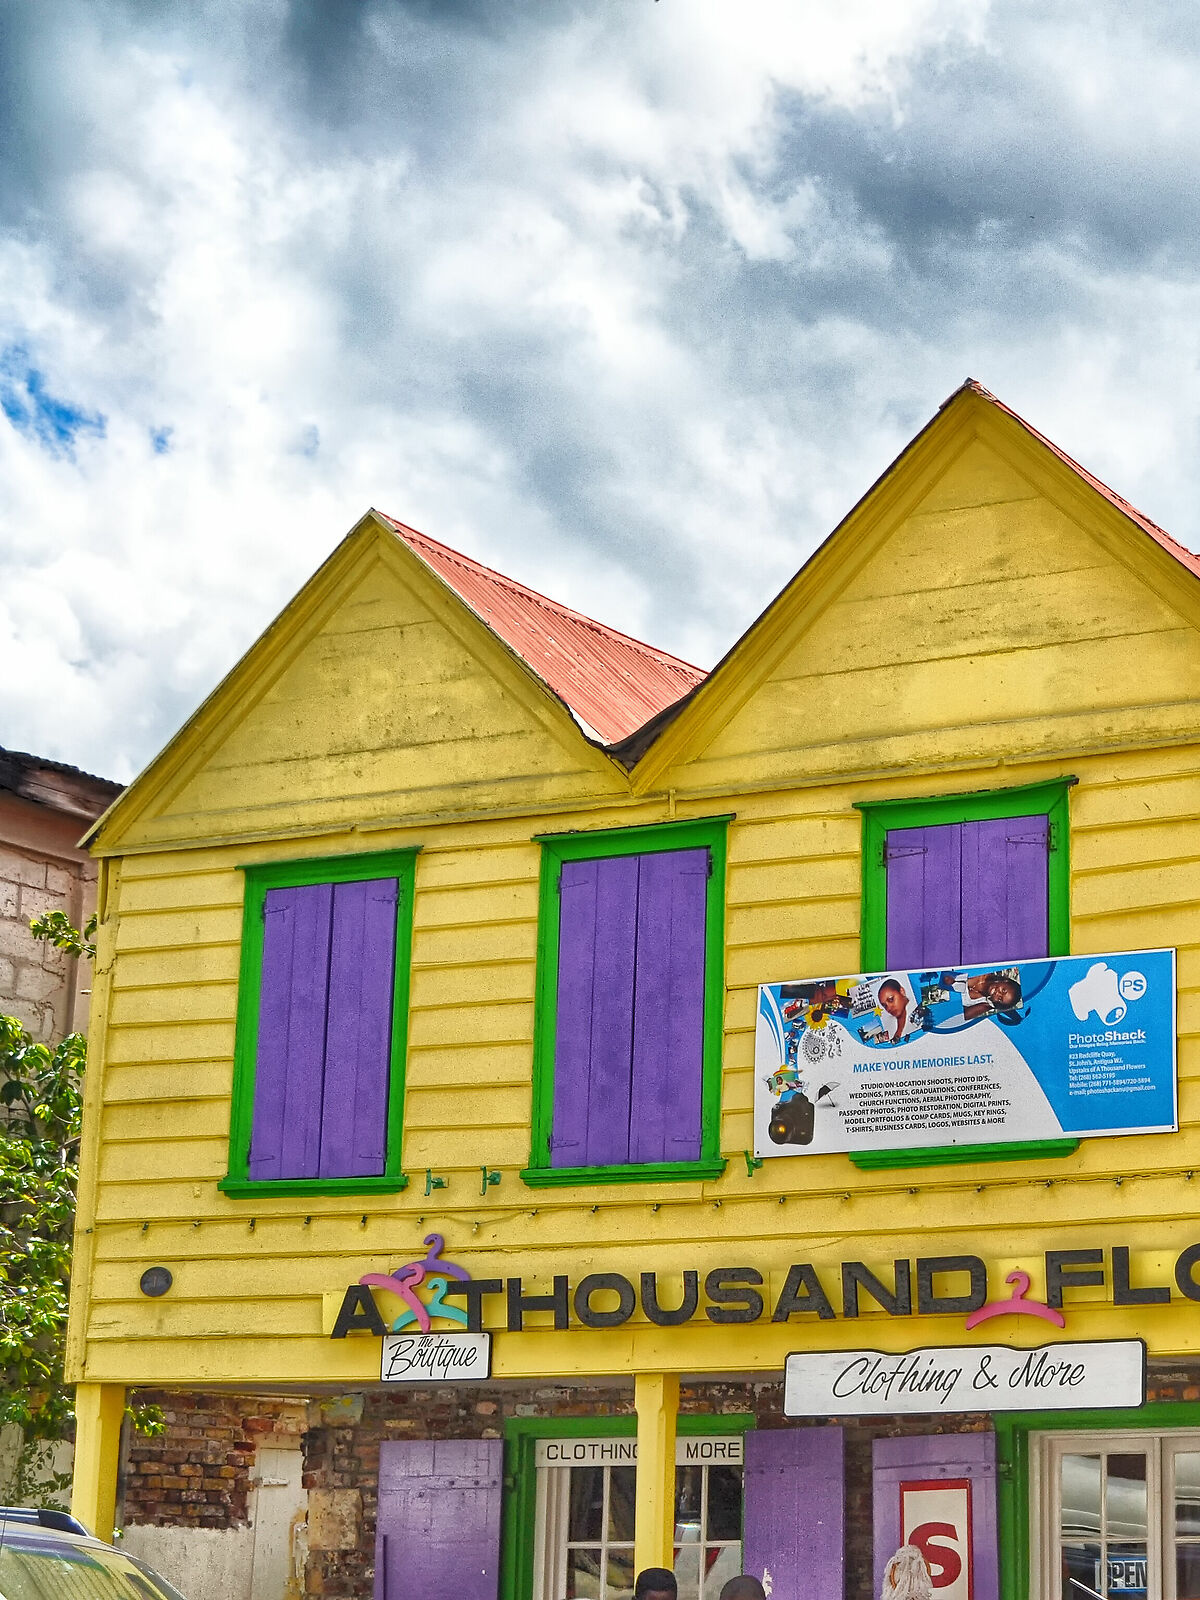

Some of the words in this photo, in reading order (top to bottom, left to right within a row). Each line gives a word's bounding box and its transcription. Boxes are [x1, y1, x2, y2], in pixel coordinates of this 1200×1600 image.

[1122, 979, 1144, 992] PS
[1068, 1029, 1146, 1044] PhotoShack
[853, 1063, 882, 1073] MAKE
[883, 1060, 910, 1071] YOUR
[912, 1056, 965, 1069] MEMORIES
[967, 1054, 994, 1065] LAST.
[1069, 1066, 1090, 1074] Upstairs
[927, 1078, 954, 1086] SHOOTS,
[954, 1076, 975, 1084] PHOTO
[849, 1091, 883, 1099] WEDDINGS,
[884, 1089, 910, 1097] PARTIES,
[911, 1086, 956, 1096] GRADUATIONS,
[956, 1083, 1002, 1092] CONFERENCES,
[885, 1097, 921, 1105] FUNCTIONS,
[945, 1092, 992, 1101] PHOTOGRAPHY,
[920, 1103, 962, 1111] RESTORATION,
[866, 1115, 904, 1123] PORTFOLIOS
[953, 1110, 973, 1118] MUGS,
[905, 1122, 927, 1130] CARDS,
[331, 1284, 388, 1339] A
[446, 1254, 987, 1334] THOUSAND
[385, 1339, 478, 1379] Boutique
[832, 1356, 962, 1405] Clothing
[972, 1354, 999, 1390] &
[1008, 1352, 1086, 1388] More
[546, 1443, 638, 1460] CLOTHIN
[686, 1442, 740, 1459] MORE
